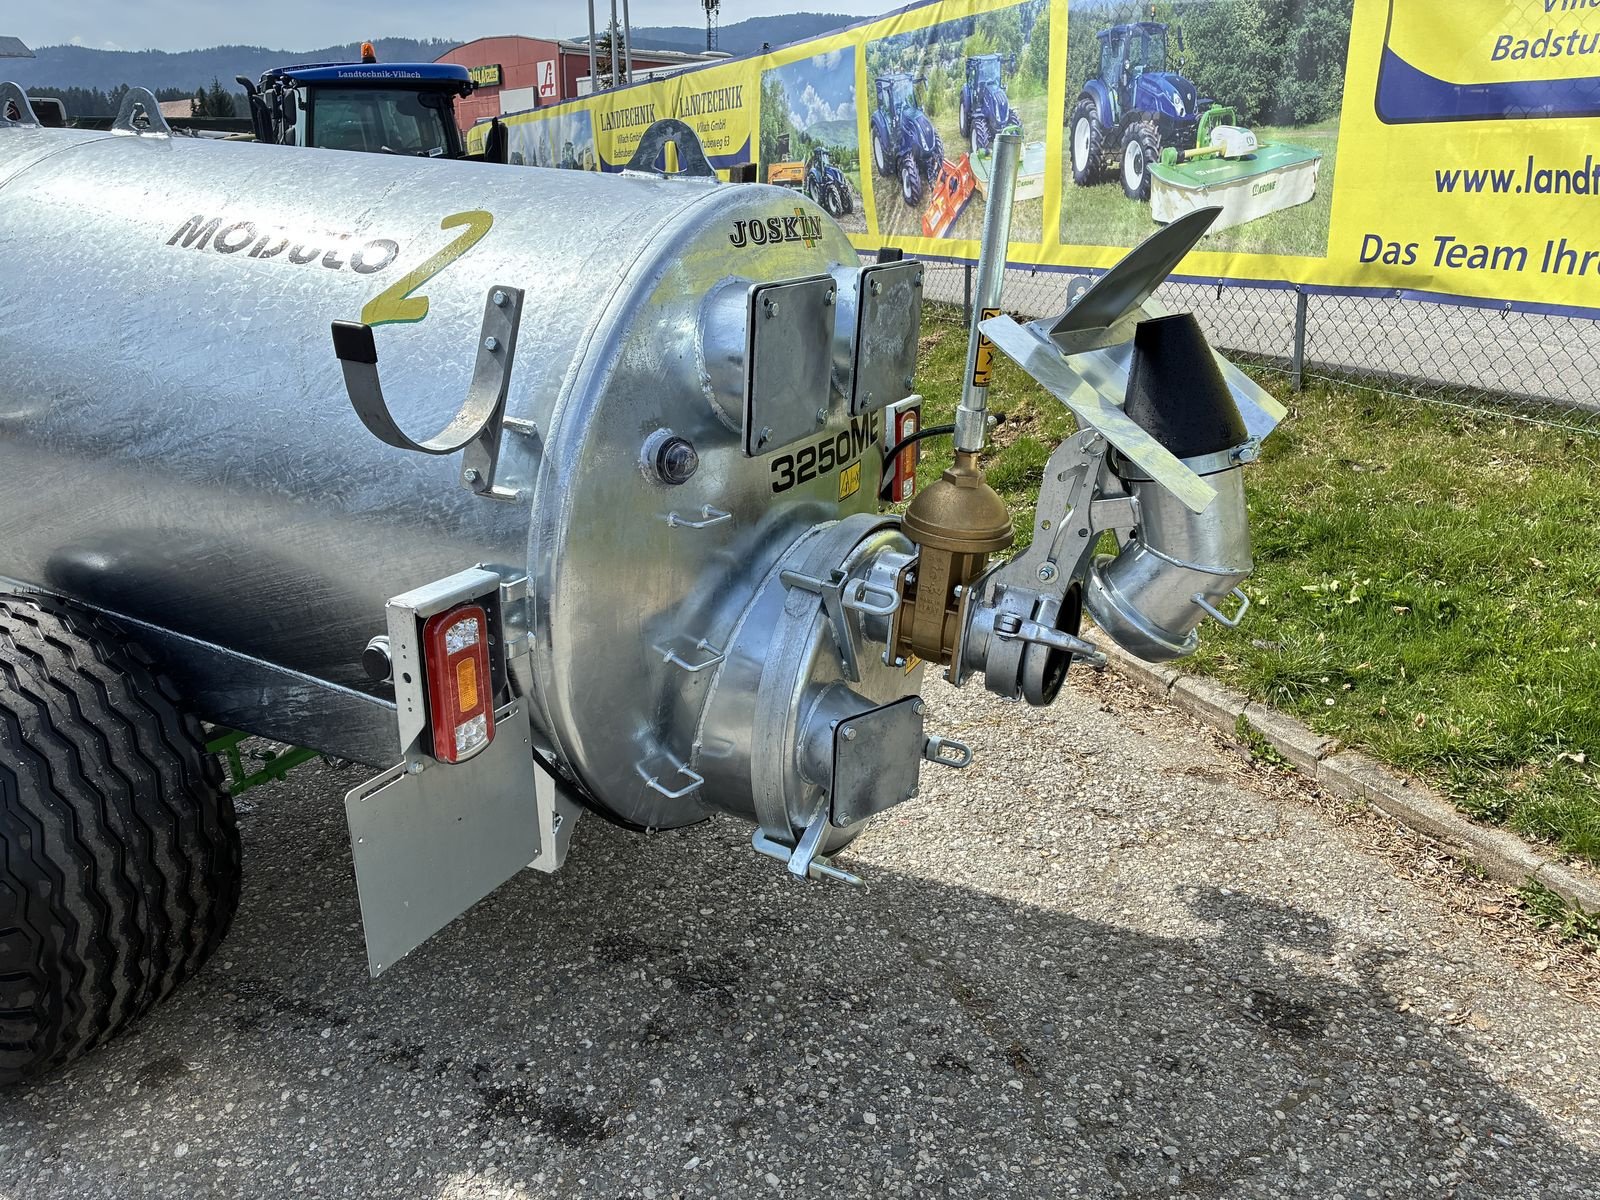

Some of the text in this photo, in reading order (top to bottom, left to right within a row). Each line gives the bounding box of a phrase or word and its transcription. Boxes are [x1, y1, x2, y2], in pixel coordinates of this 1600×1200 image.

[338, 70, 421, 79] Landtechnik-Villach
[600, 103, 656, 132] LANDTECHNIK
[679, 85, 743, 118] LANDTECHNIK
[729, 214, 823, 248] JOSKIN
[361, 210, 494, 327] 2
[1359, 233, 1600, 276] Das Team Ihr
